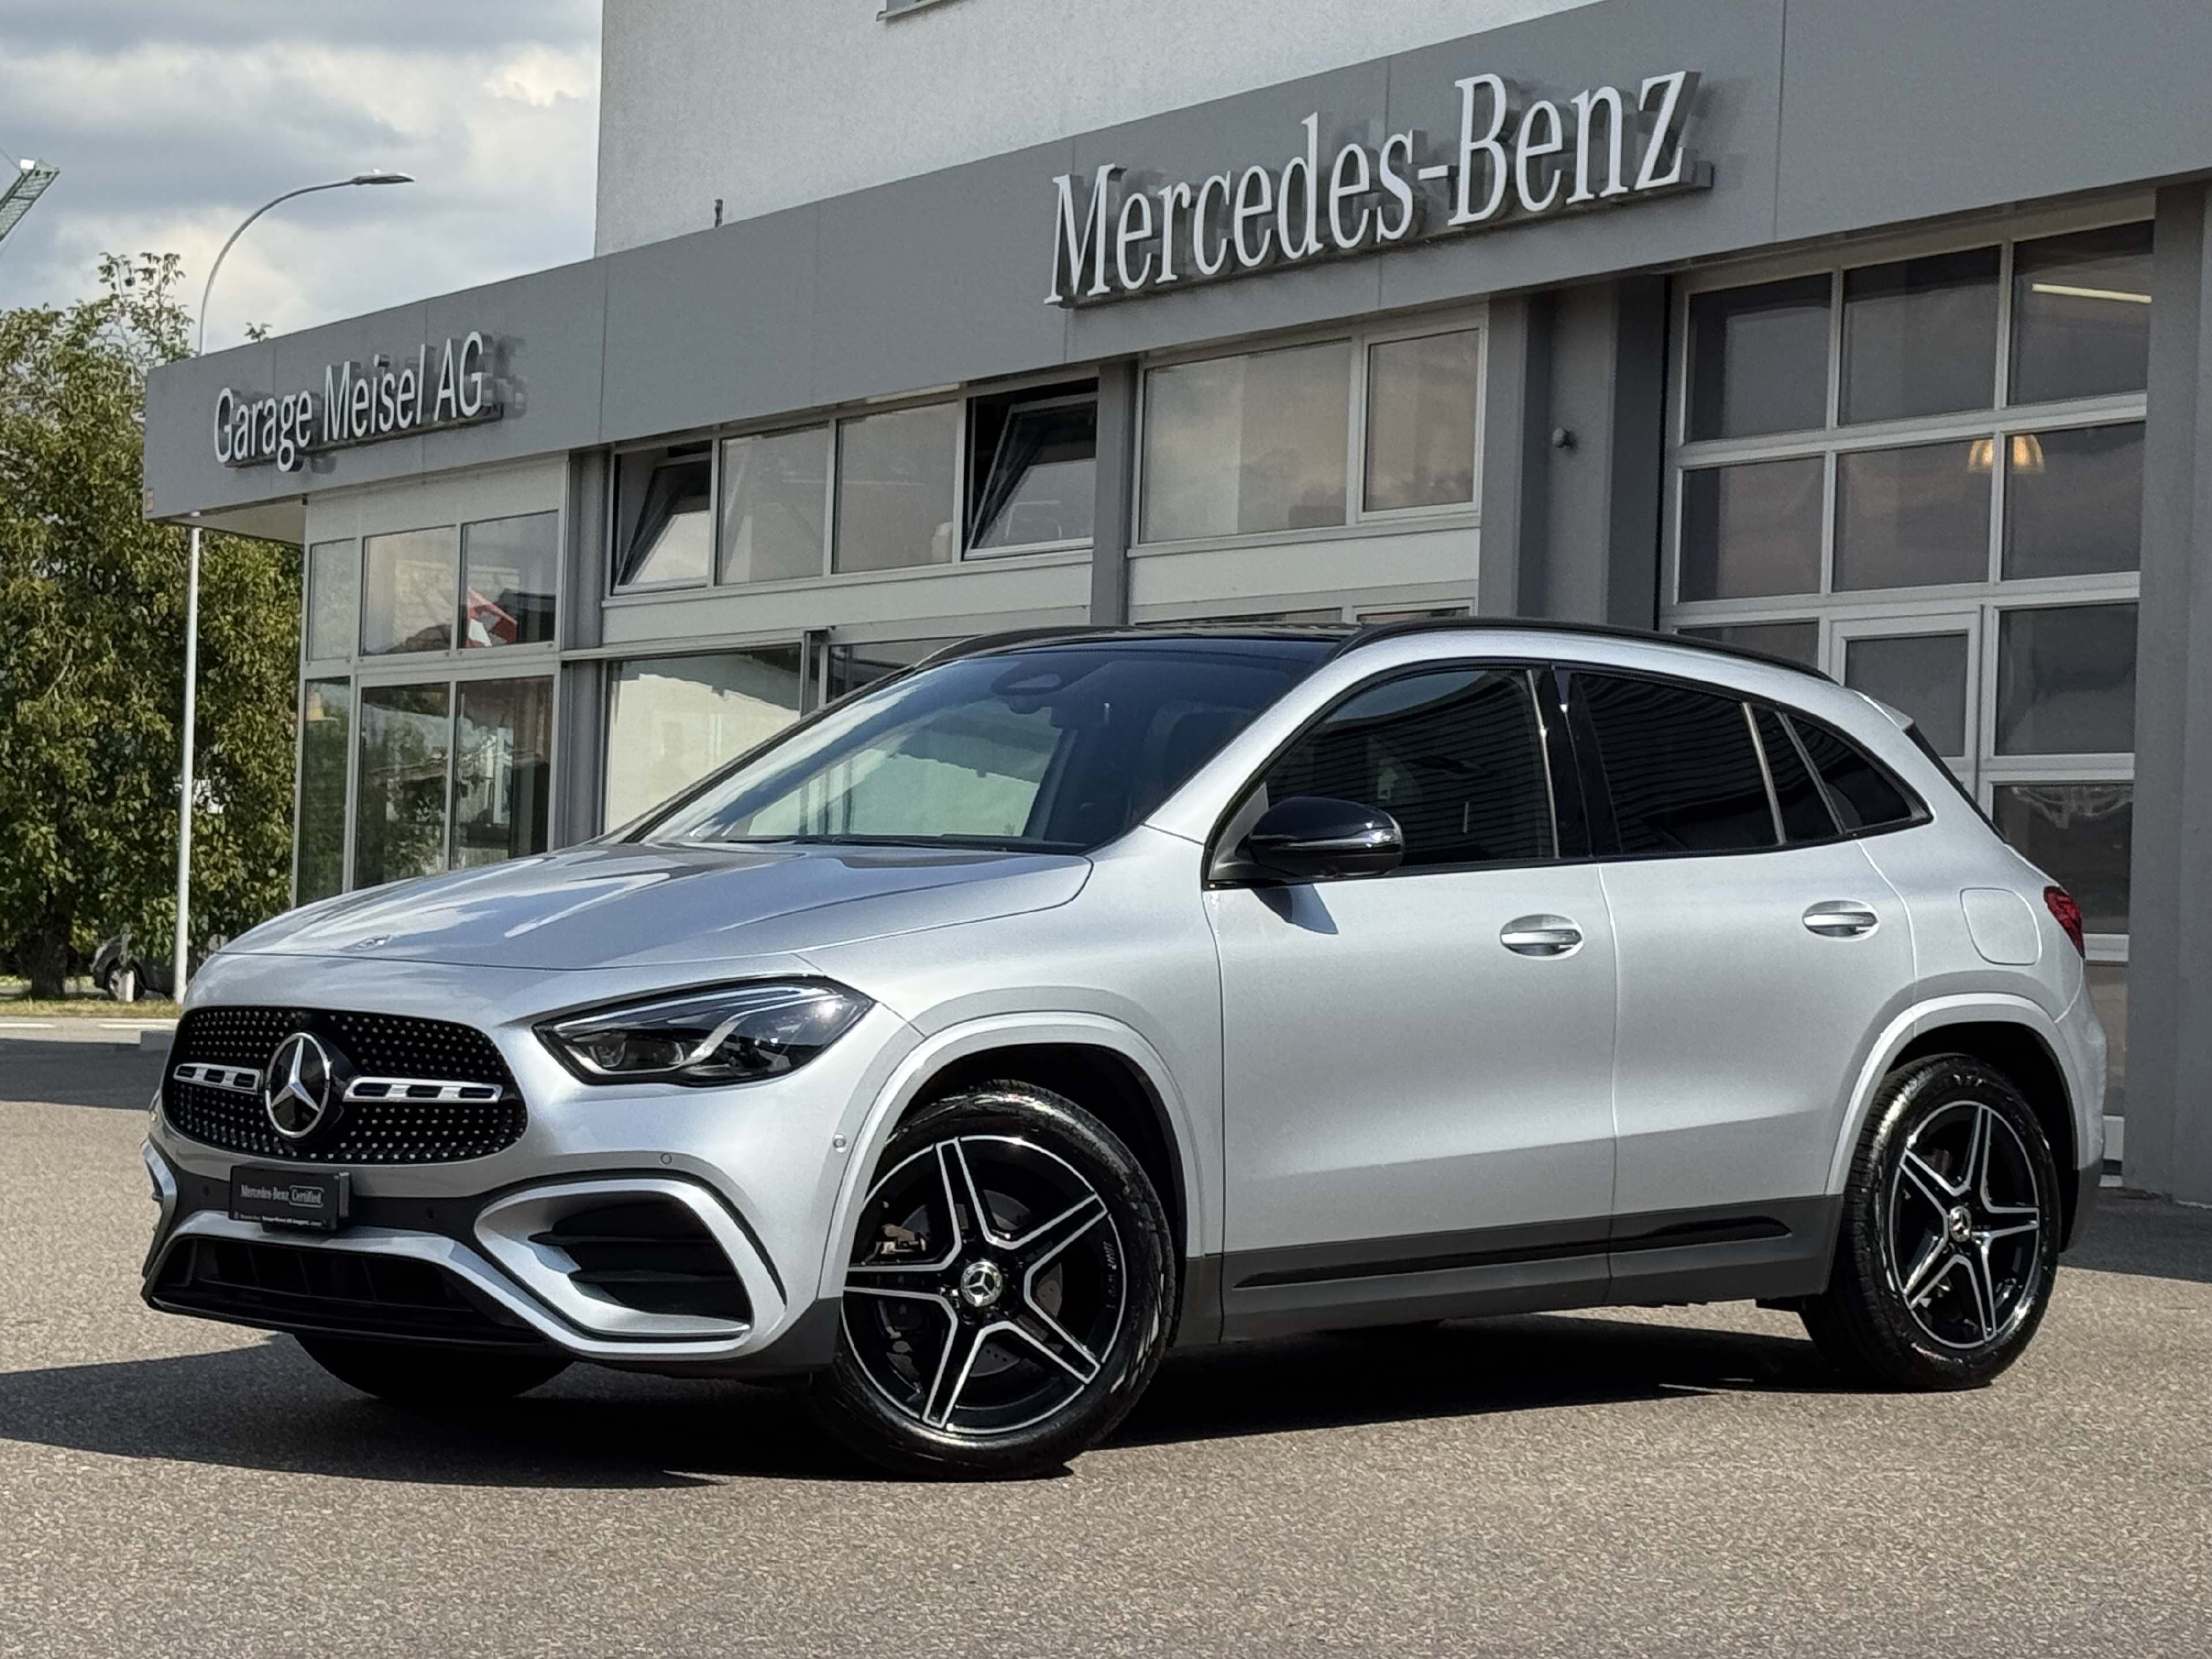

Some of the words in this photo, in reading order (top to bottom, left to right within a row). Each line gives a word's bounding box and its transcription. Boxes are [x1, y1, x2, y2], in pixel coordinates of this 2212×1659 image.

[1044, 70, 1693, 304] Mercedes-Benz
[214, 387, 312, 472] Garage
[323, 342, 426, 441] Meisel
[434, 330, 484, 422] AG
[292, 1188, 322, 1204] Certified
